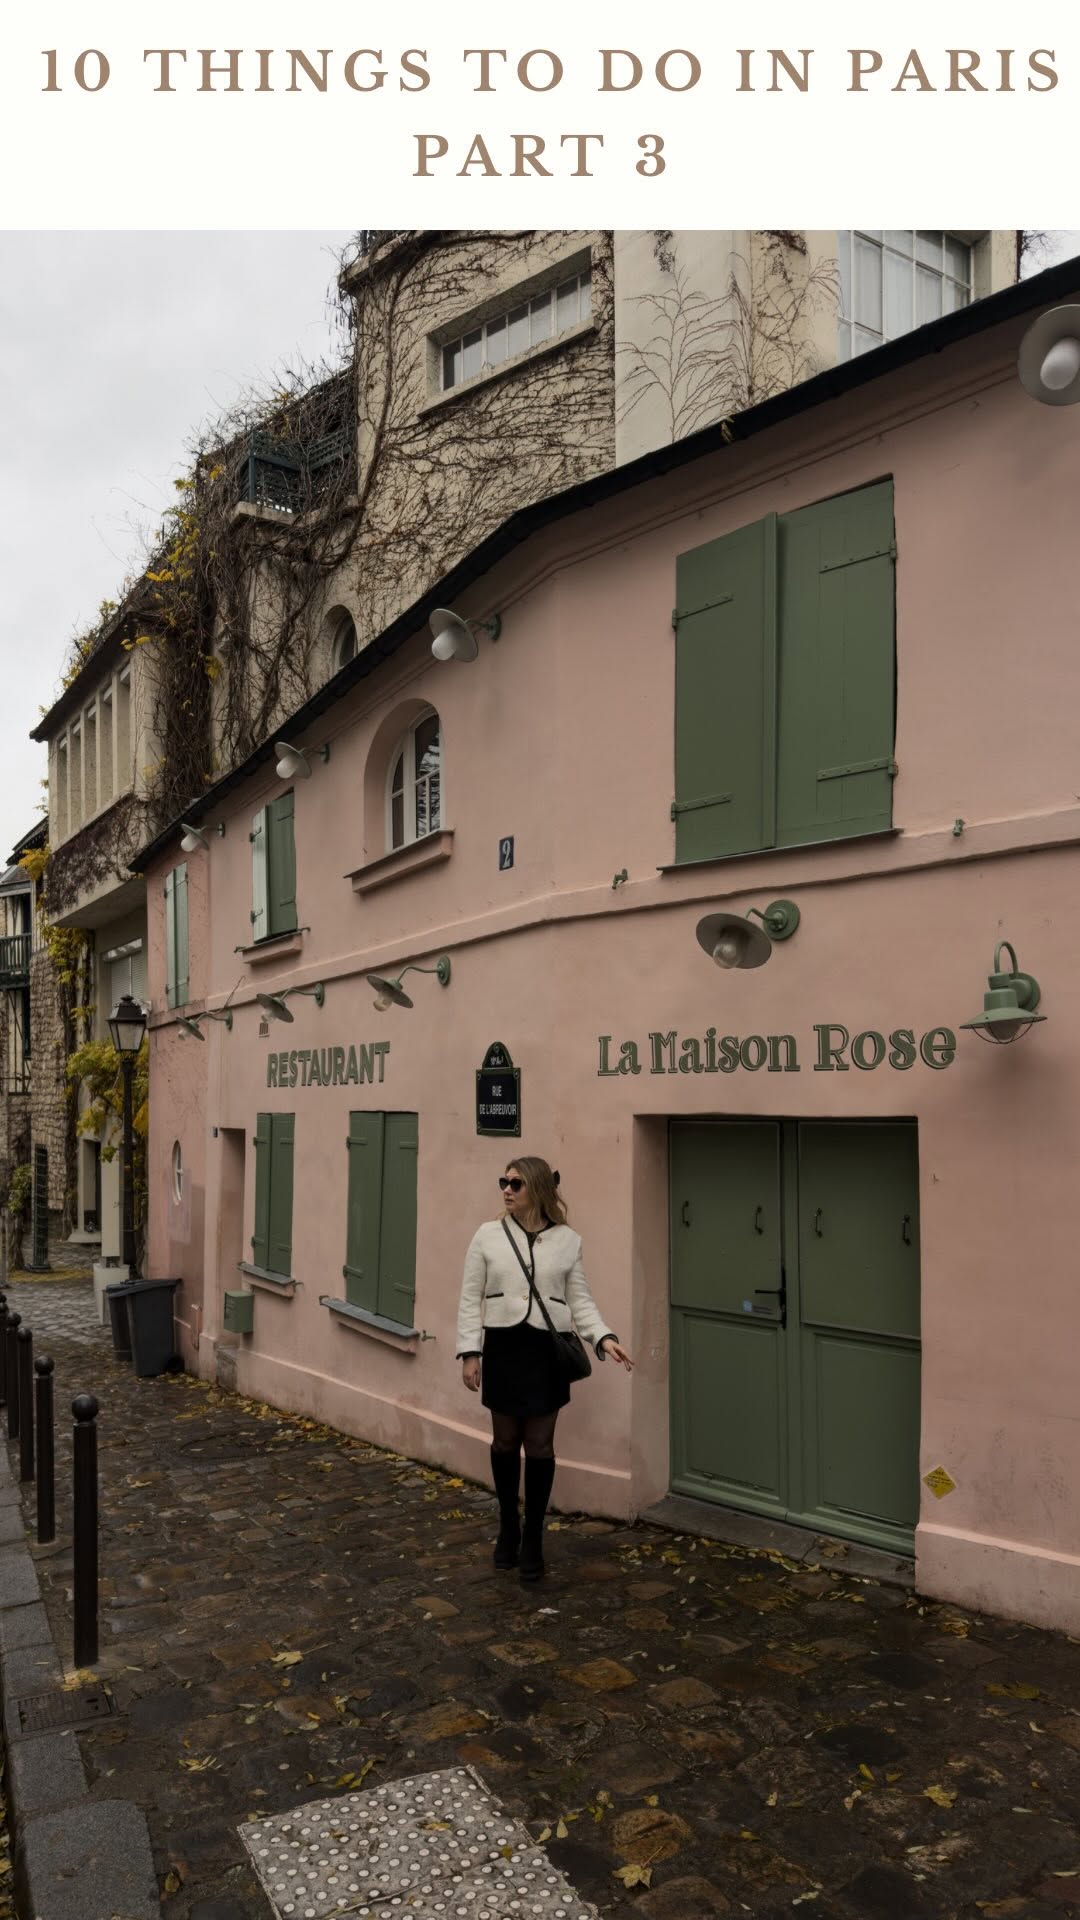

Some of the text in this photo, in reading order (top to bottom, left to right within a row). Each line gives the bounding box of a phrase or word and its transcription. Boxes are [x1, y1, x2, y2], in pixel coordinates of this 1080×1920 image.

[502, 840, 511, 868] 2
[598, 1024, 957, 1076] La Maison Rose
[267, 1041, 390, 1088] RESTAURANT
[492, 1085, 502, 1096] RUE
[479, 1103, 486, 1115] DE
